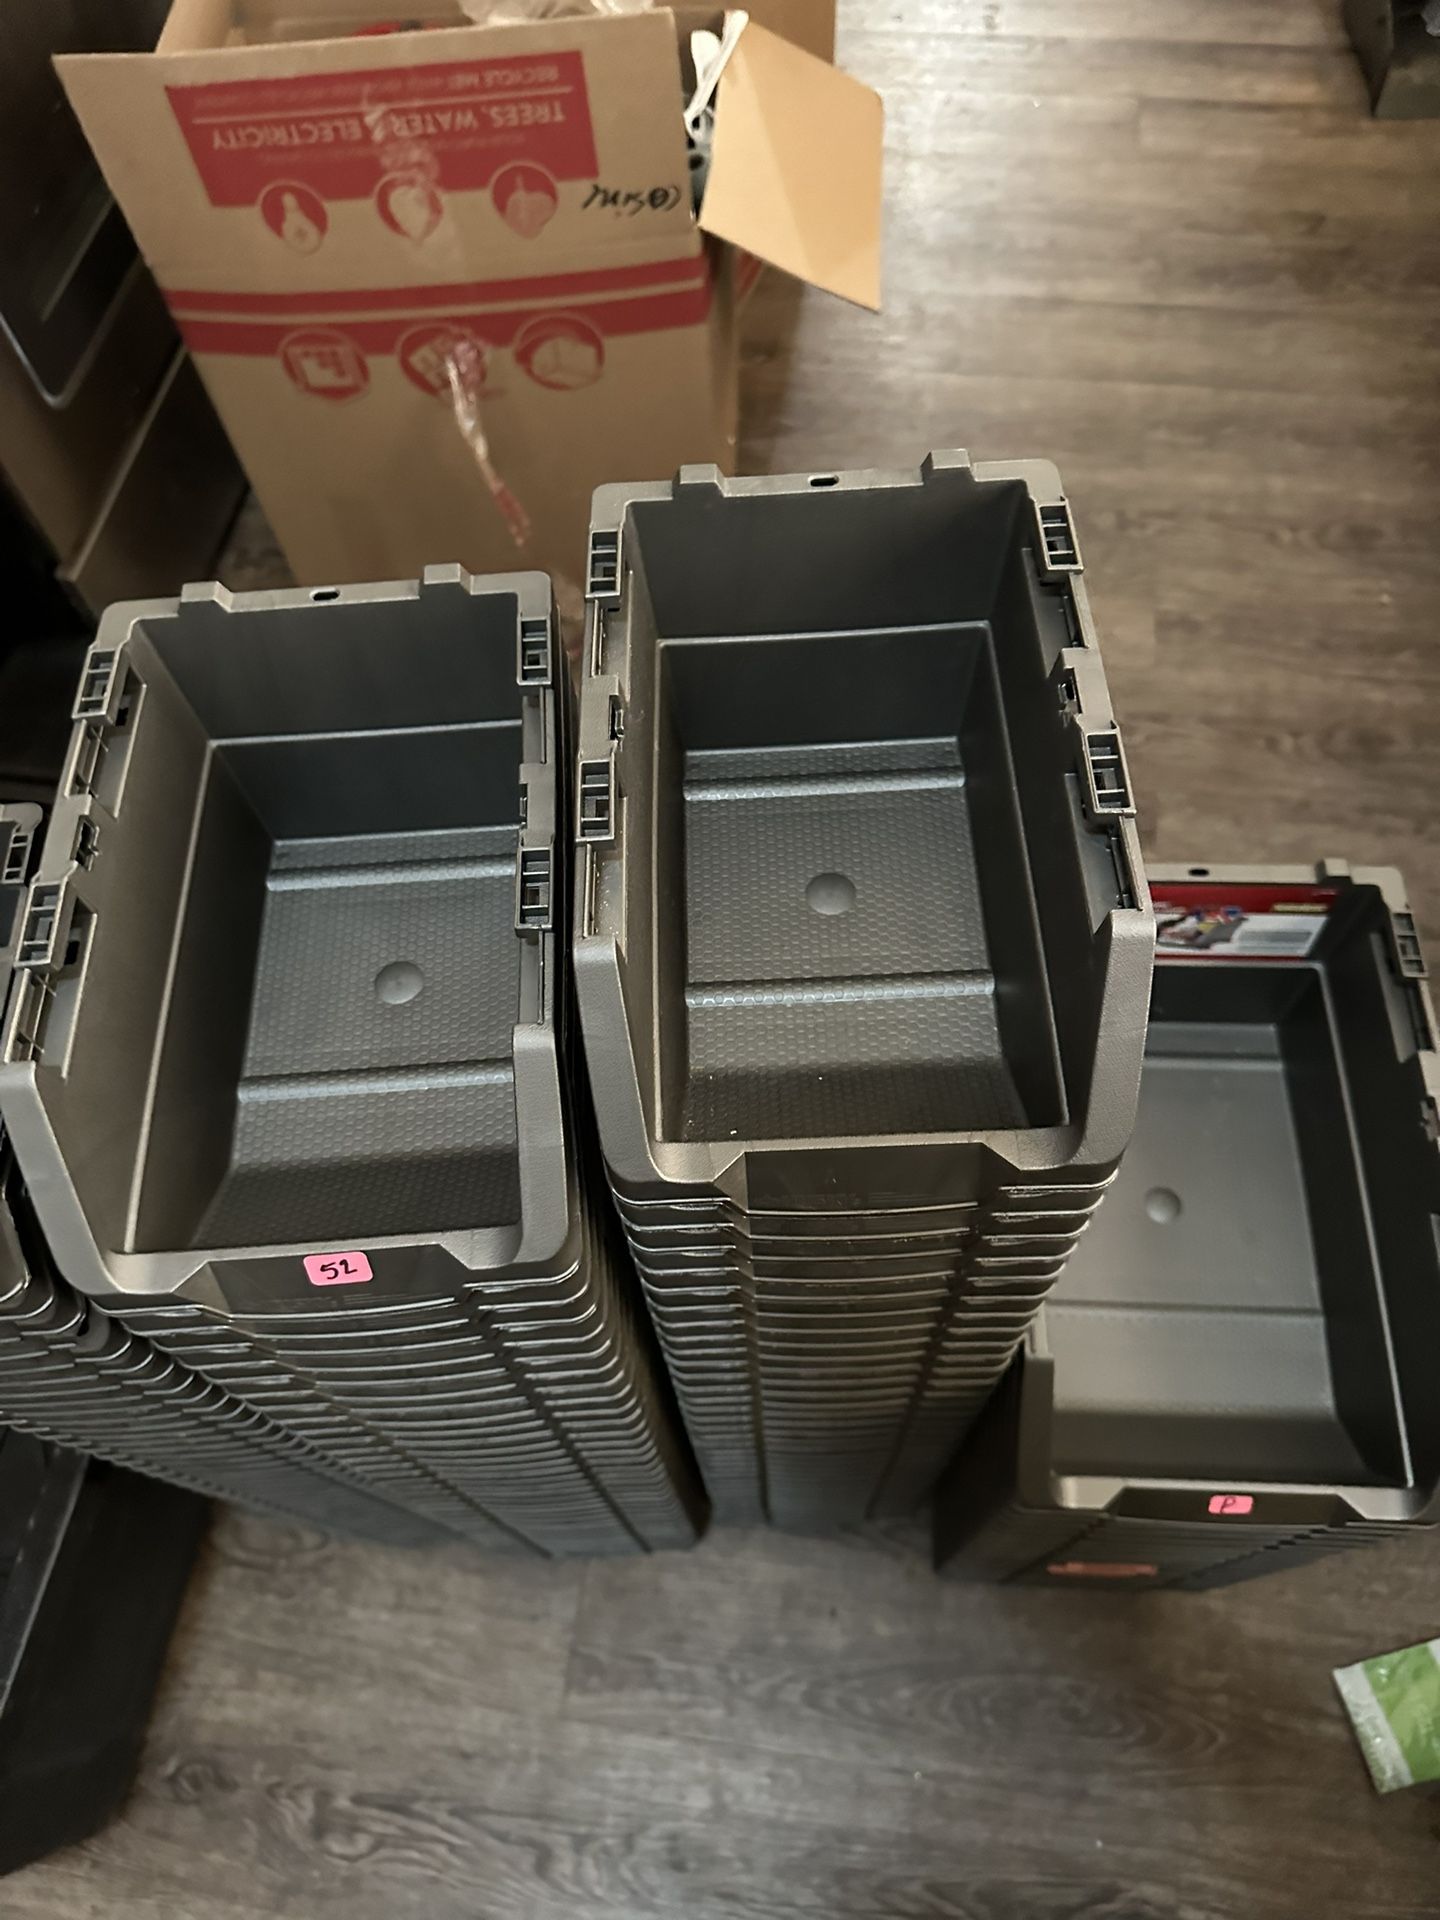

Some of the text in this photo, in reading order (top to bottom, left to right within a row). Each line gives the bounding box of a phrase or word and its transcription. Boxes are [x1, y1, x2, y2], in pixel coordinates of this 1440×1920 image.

[483, 66, 559, 87] RECYCLE
[391, 110, 480, 137] WATER
[481, 101, 565, 129] TREES,
[212, 117, 363, 151] ELECTRICITY
[320, 1259, 358, 1280] 52
